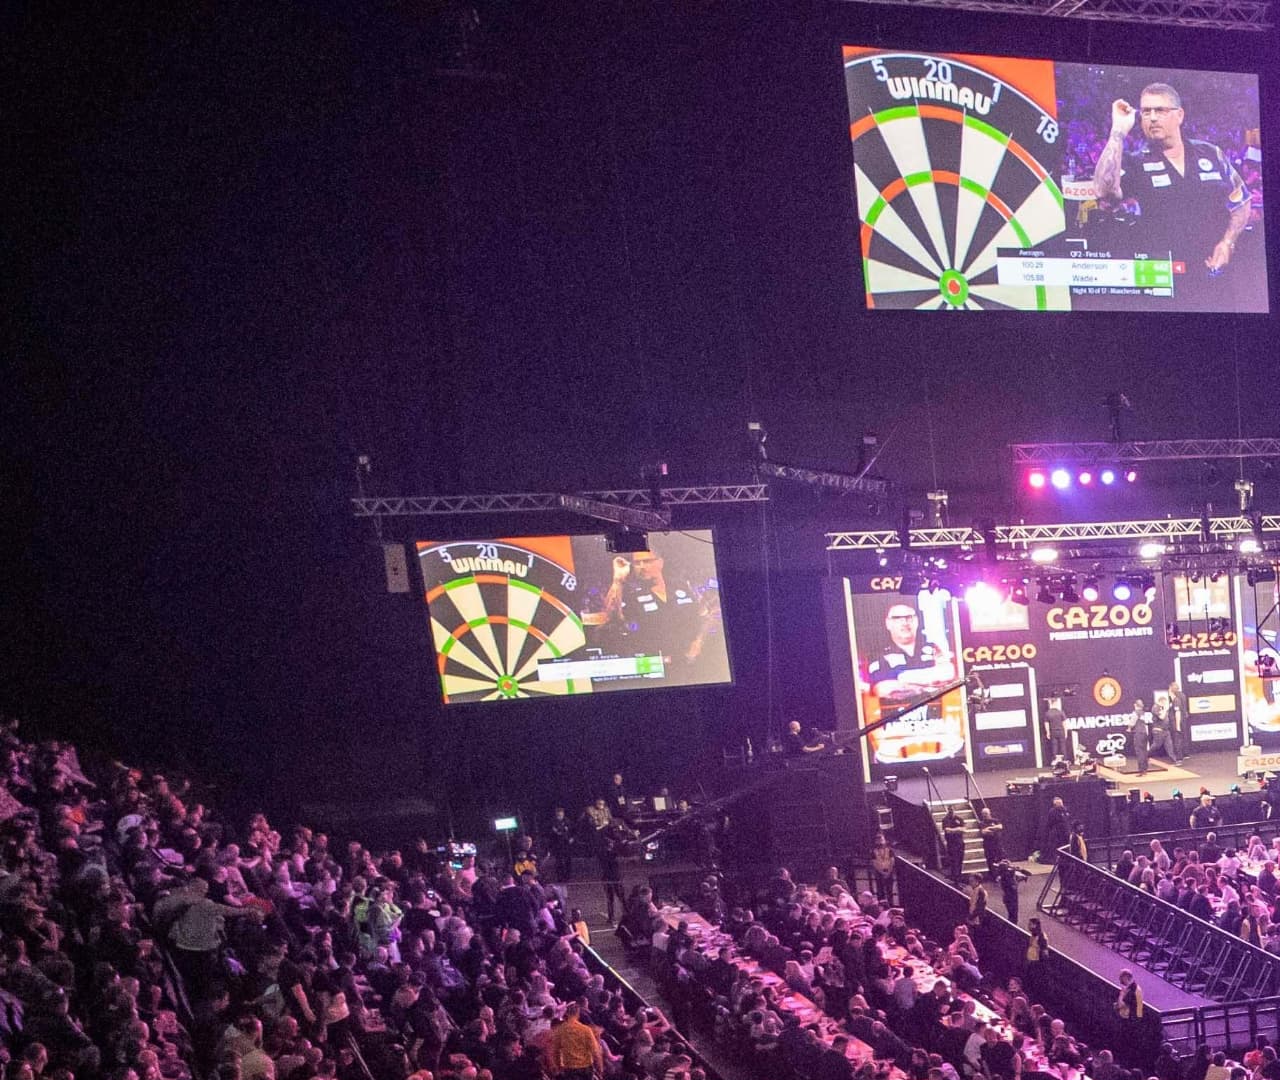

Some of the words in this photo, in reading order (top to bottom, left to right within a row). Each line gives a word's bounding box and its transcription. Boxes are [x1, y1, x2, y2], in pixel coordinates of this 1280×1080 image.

[871, 58, 888, 81] 5
[924, 58, 952, 83] 20
[992, 82, 1001, 103] 1
[1035, 115, 1059, 144] 18
[438, 548, 451, 563] 5
[476, 544, 498, 559] 20
[560, 573, 577, 591] 18
[1047, 603, 1153, 629] CAZOO
[963, 643, 1037, 662] CAZOO
